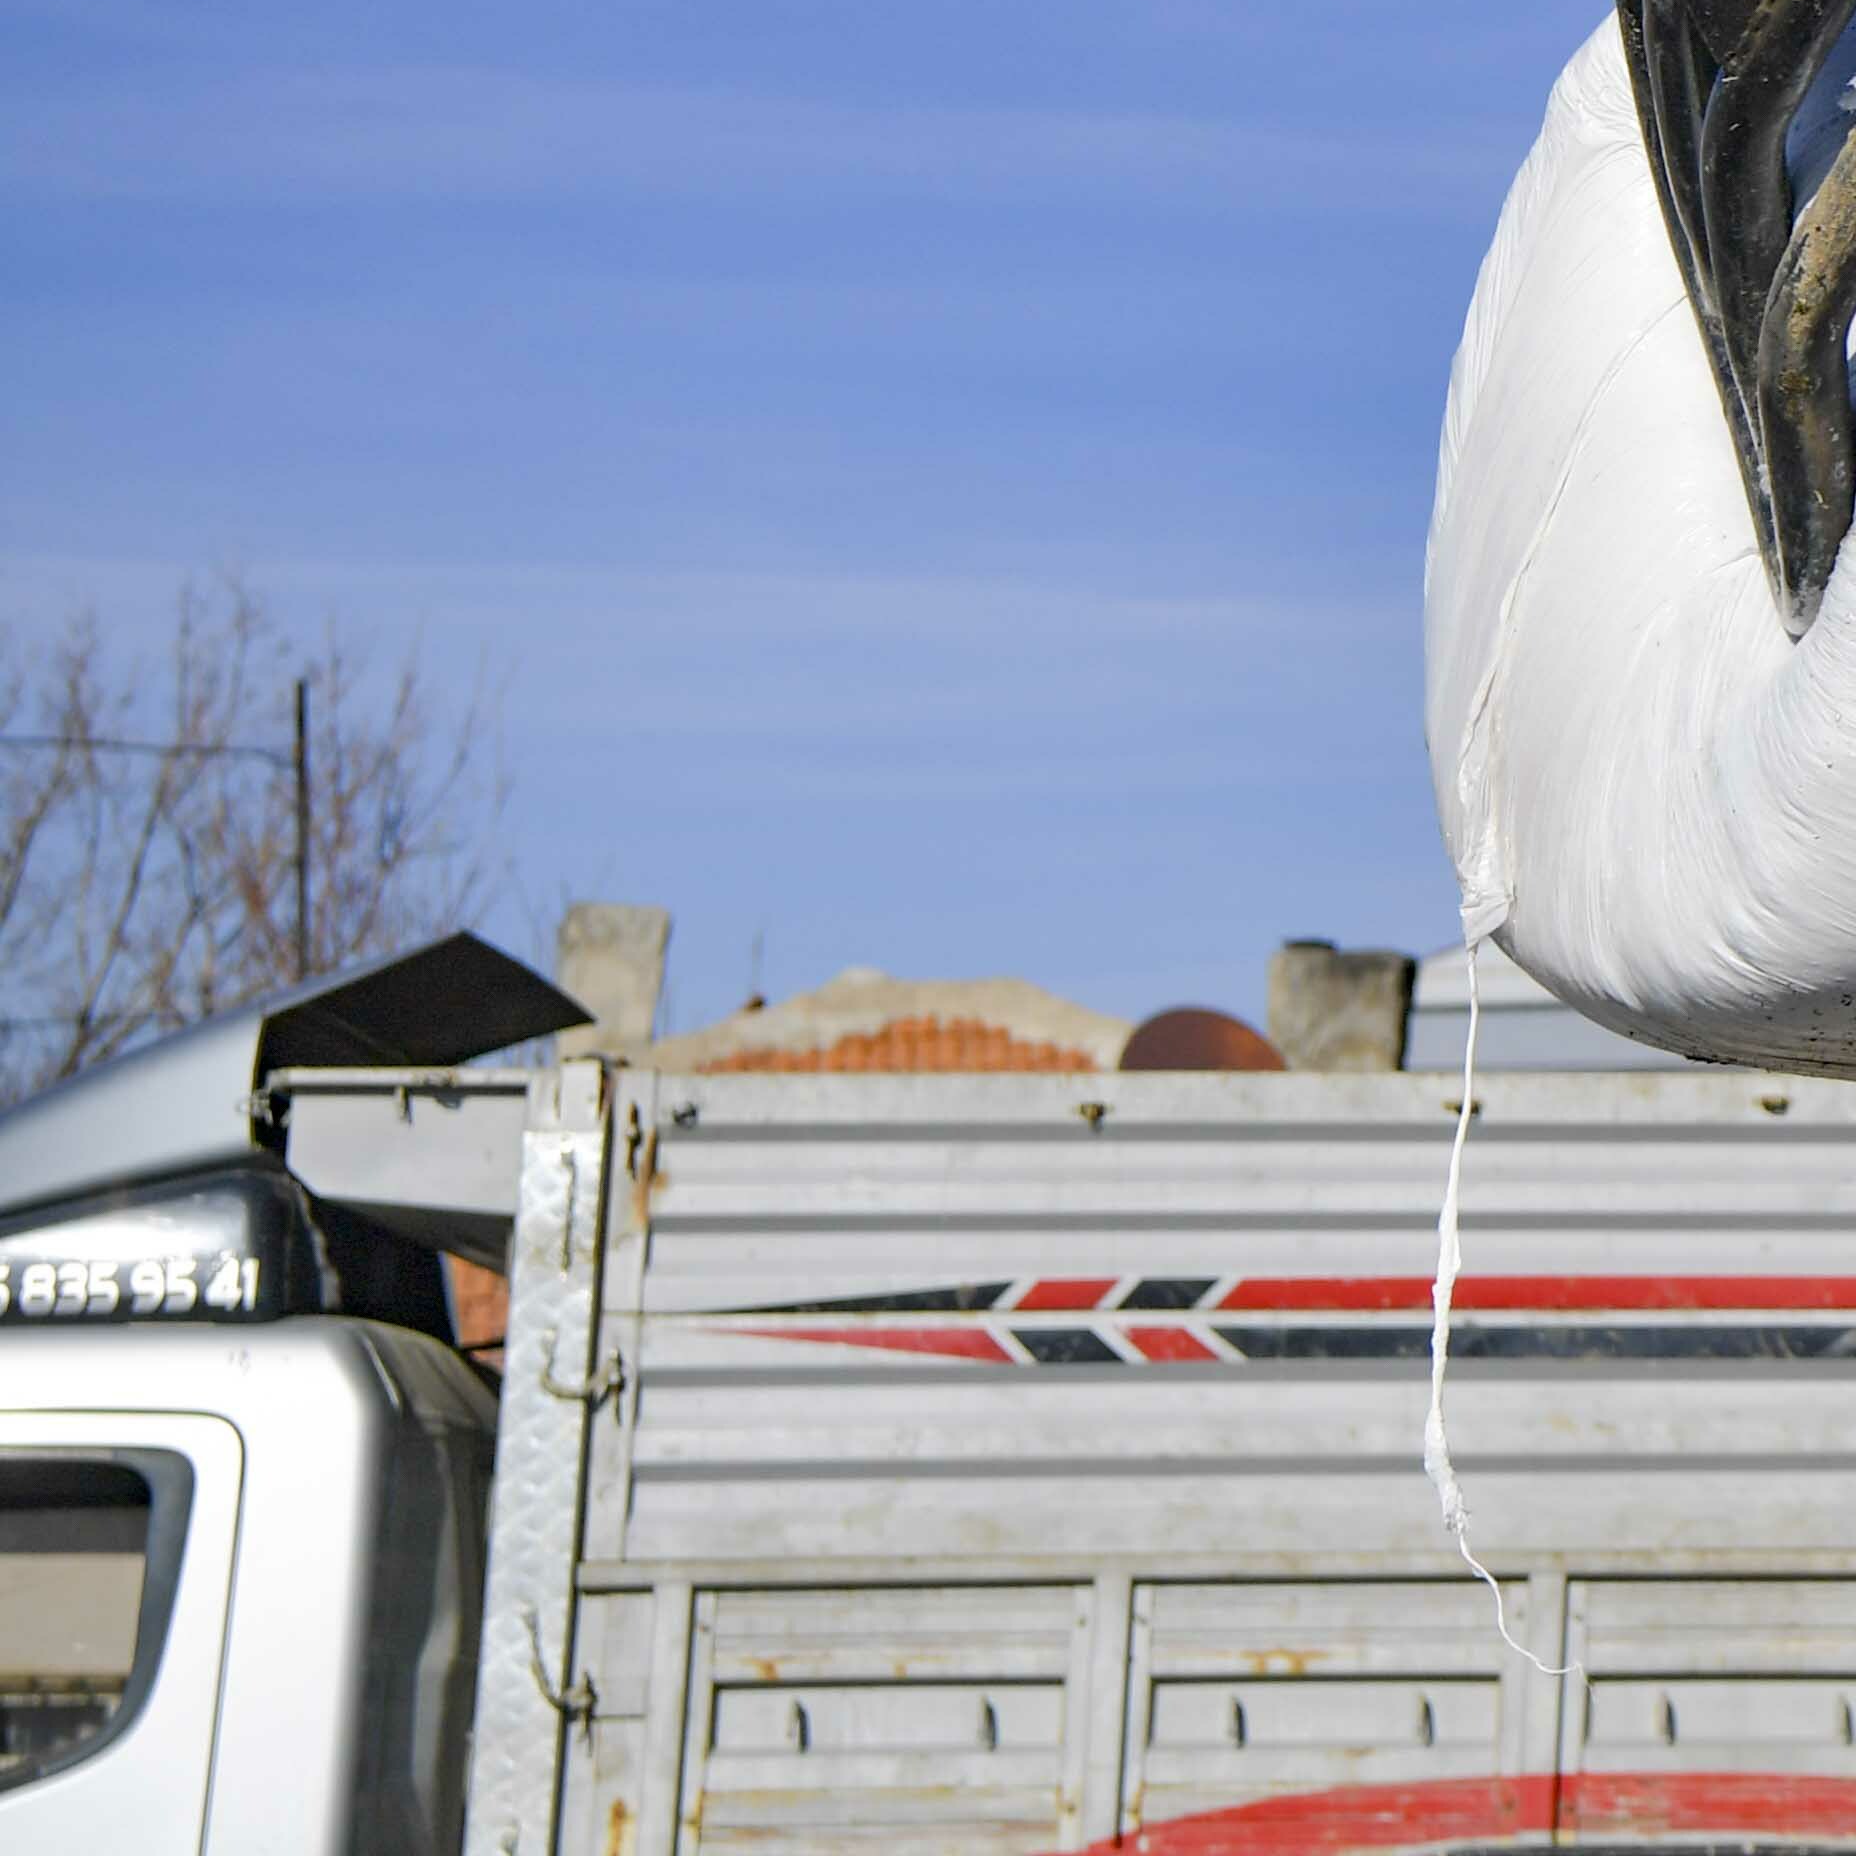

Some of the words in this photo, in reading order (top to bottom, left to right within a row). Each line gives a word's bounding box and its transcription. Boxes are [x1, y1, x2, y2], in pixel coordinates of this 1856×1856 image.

[20, 1260, 120, 1316] 835
[130, 1258, 197, 1313] 95
[205, 1251, 260, 1312] 41
